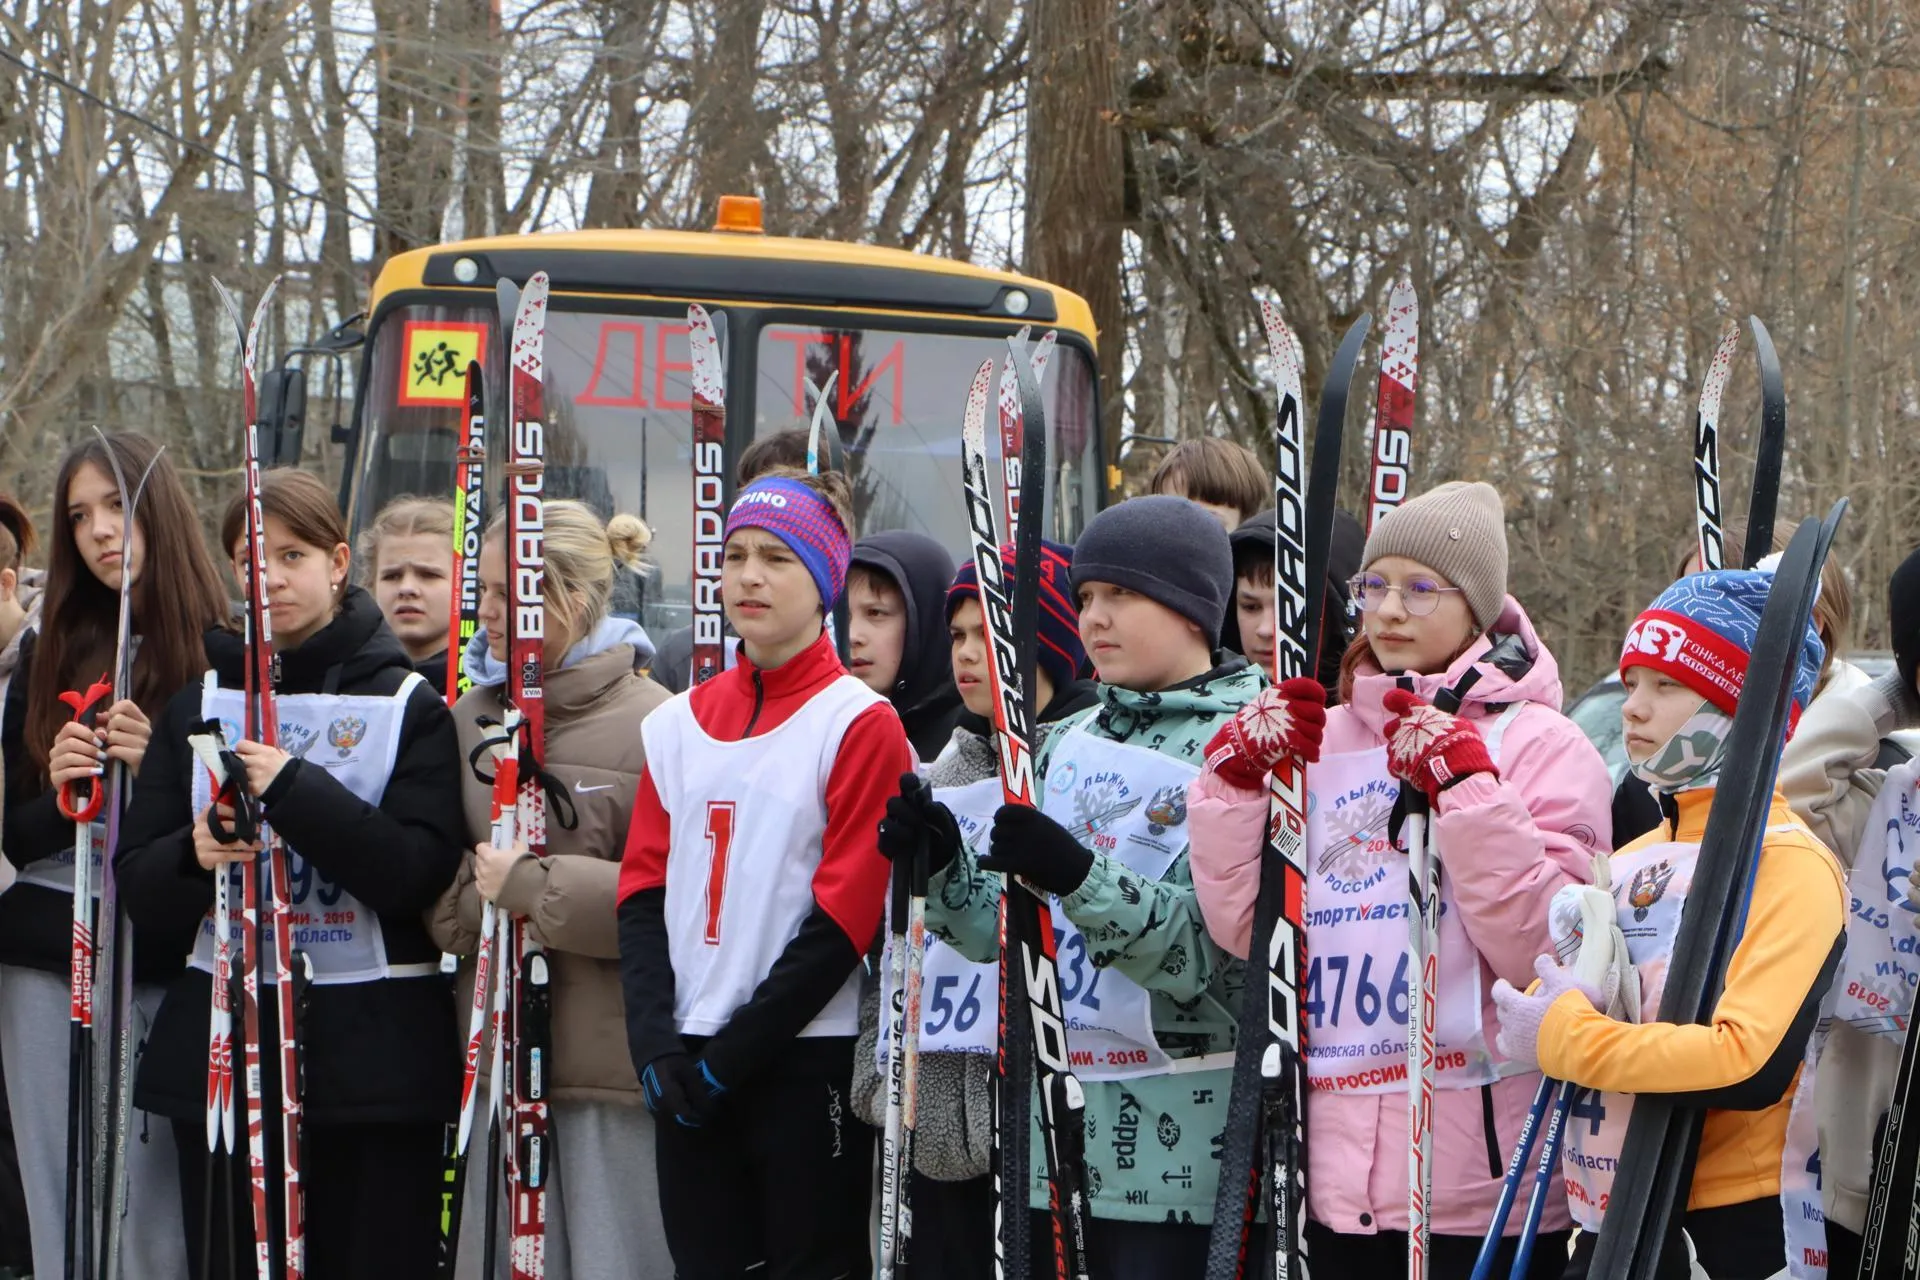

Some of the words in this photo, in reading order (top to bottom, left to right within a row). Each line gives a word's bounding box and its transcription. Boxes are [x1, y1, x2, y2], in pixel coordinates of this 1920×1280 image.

[516, 422, 544, 639] BRADOS
[695, 442, 723, 645] BRADOS
[1276, 390, 1308, 680] BRADOS
[962, 438, 1030, 749] BRADOS
[523, 661, 536, 686] 190
[1683, 637, 1726, 672] ГОНКА
[281, 722, 310, 740] ЖНЯ
[1083, 771, 1130, 798] ЛЫЖНЯ
[1334, 779, 1400, 809] ЛЫЖНЯ
[1094, 834, 1118, 850] 2018
[704, 801, 736, 945] 1
[1325, 866, 1387, 895] РОССИИ
[324, 910, 355, 925] 2019
[72, 948, 83, 1007] SPORT
[82, 956, 92, 1014] SPORT
[1306, 952, 1409, 1029] 4766
[1847, 980, 1891, 1013] 2018
[924, 973, 982, 1036] 56
[1409, 983, 1418, 1058] TOURING
[1106, 1050, 1149, 1065] 2018
[1336, 1063, 1409, 1091] РОССИИ
[1434, 1051, 1467, 1072] 018
[1111, 1091, 1142, 1171] Kappa
[1518, 1113, 1535, 1146] SOCHI
[1546, 1109, 1562, 1141] SOCHI
[1571, 1087, 1606, 1136] 4
[884, 1138, 895, 1195] carbon
[1507, 1146, 1523, 1177] 2014
[1538, 1143, 1553, 1175] 2014
[1863, 1185, 1886, 1272] WOOD
[1880, 1103, 1902, 1185] CORE
[880, 1203, 891, 1250] style
